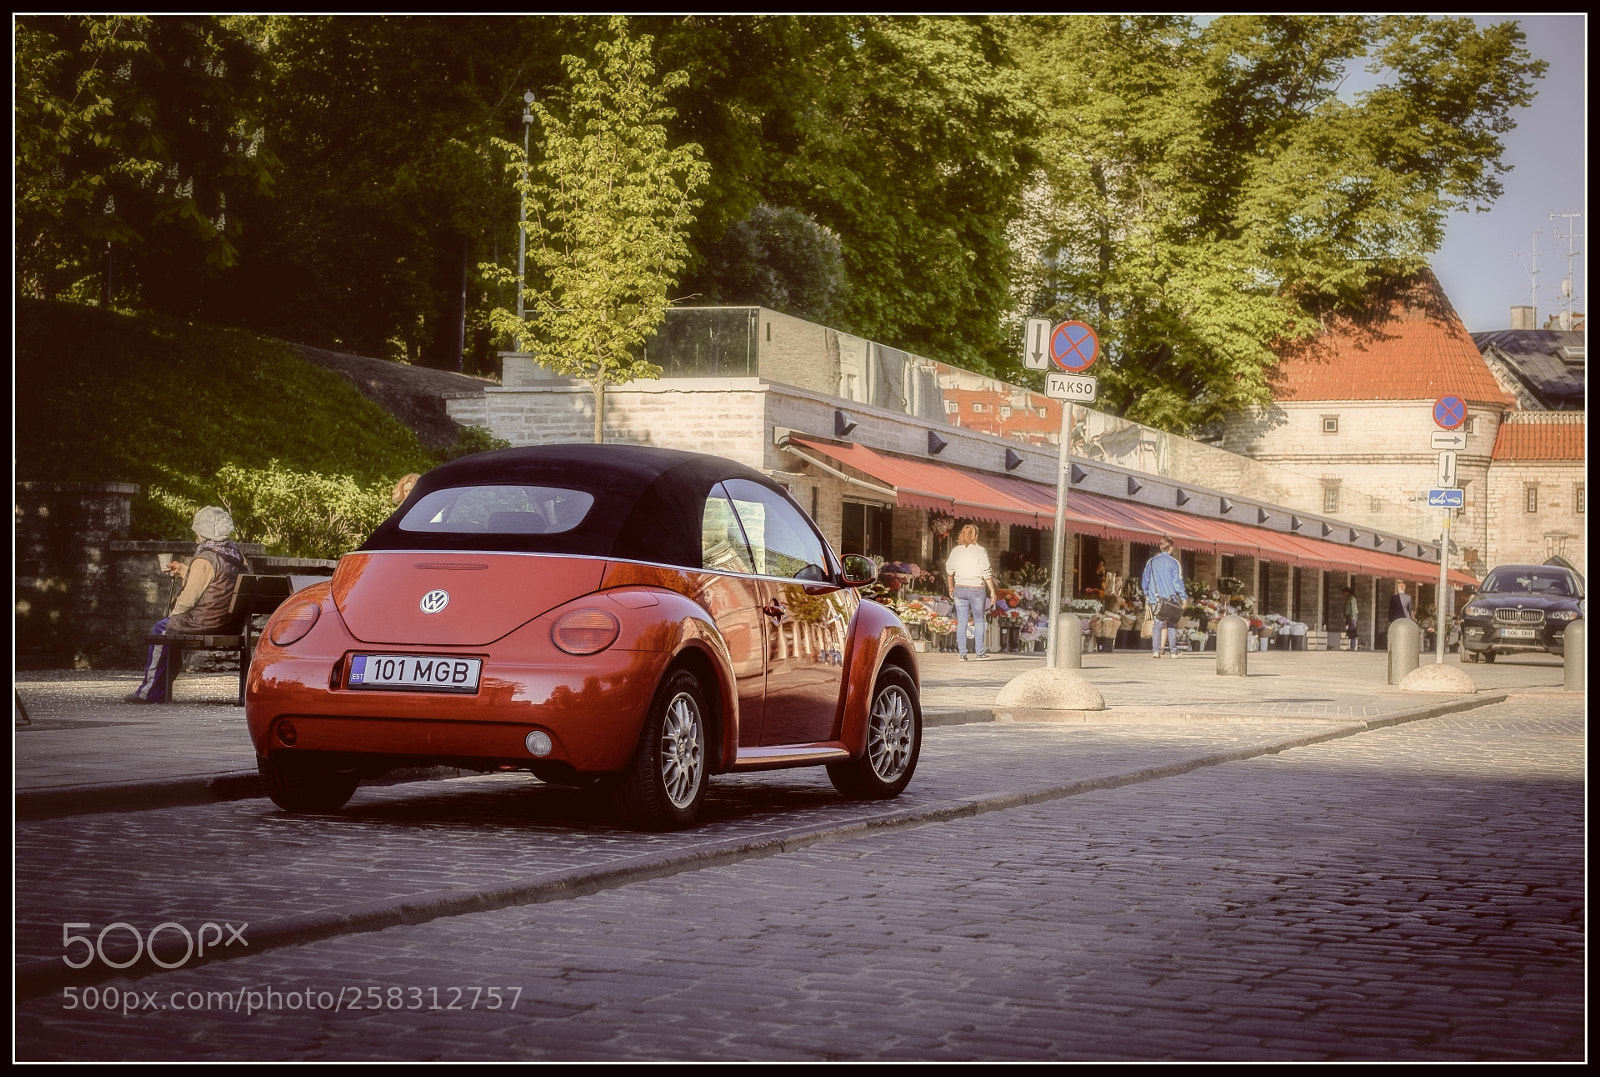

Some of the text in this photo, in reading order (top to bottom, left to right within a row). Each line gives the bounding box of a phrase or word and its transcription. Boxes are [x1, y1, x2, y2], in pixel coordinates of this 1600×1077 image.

[1051, 380, 1093, 394] TAKSO
[374, 659, 469, 683] 101 MGB
